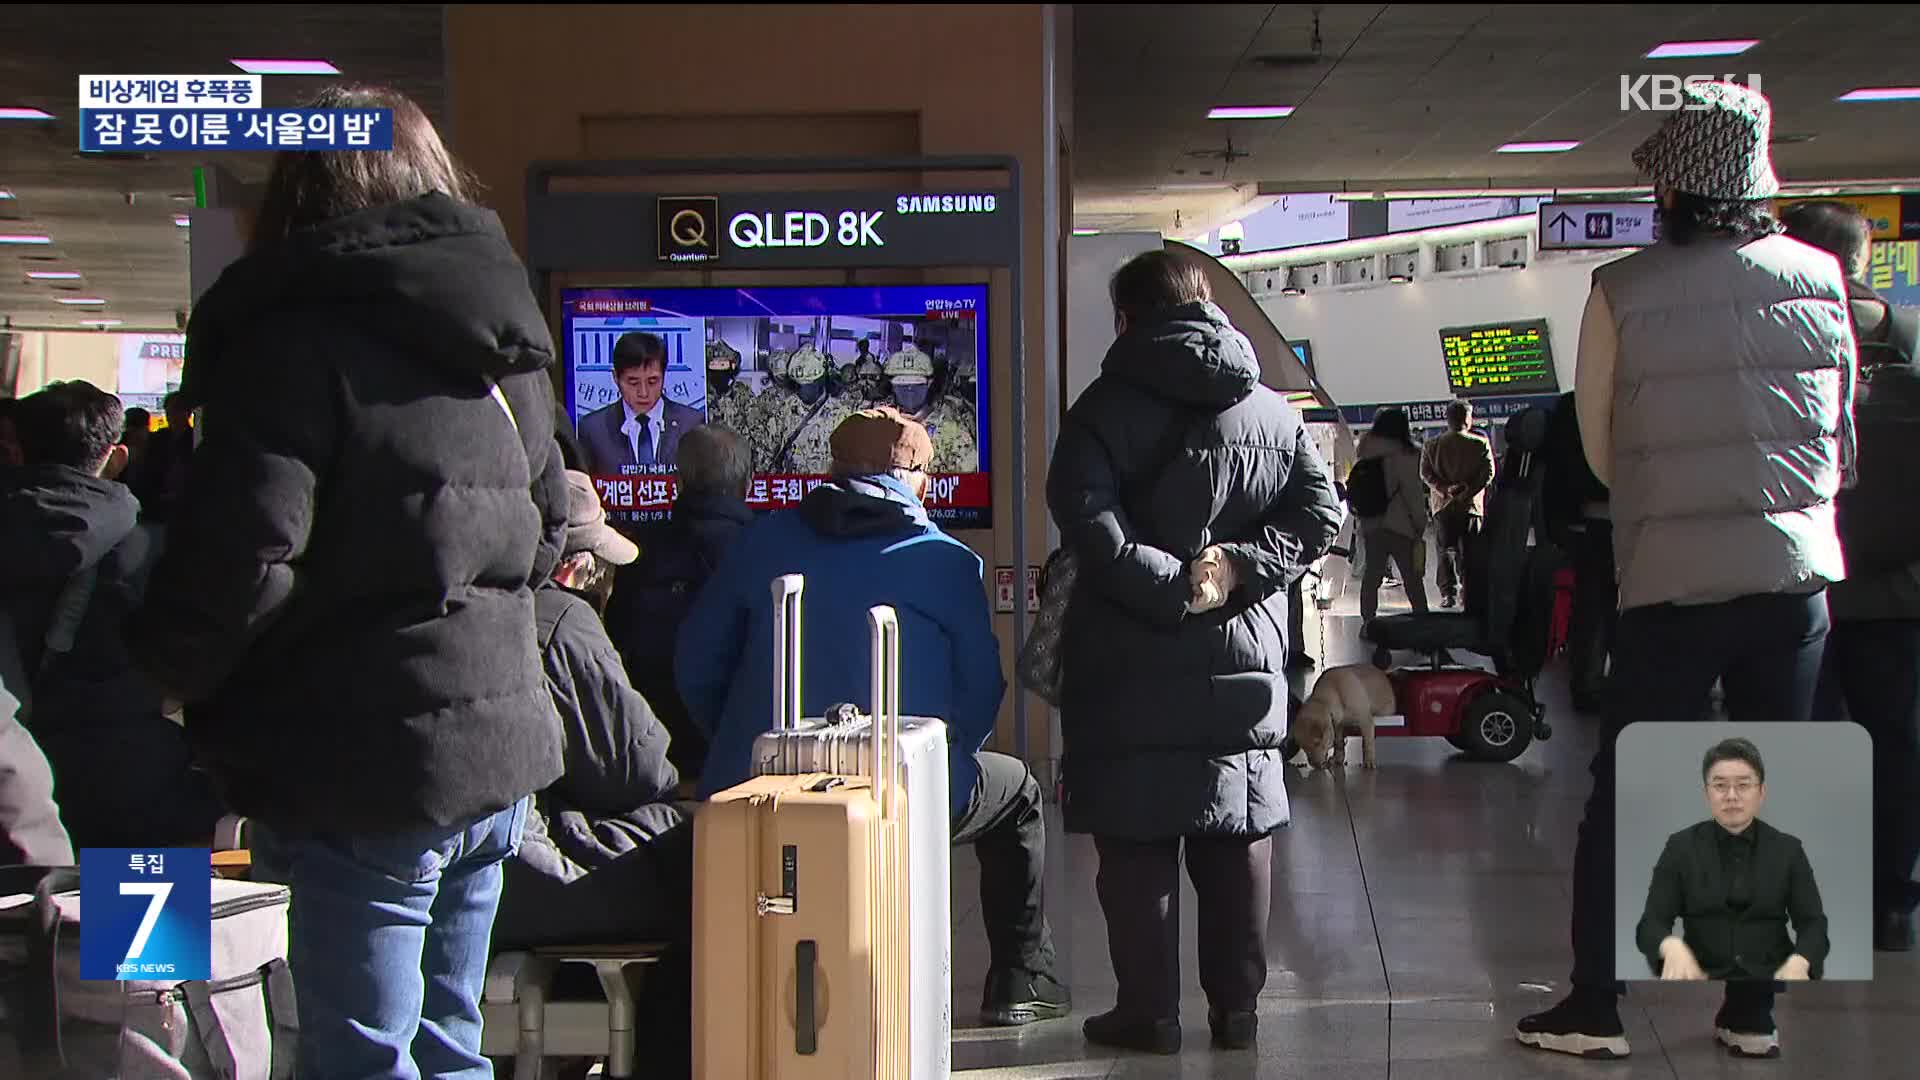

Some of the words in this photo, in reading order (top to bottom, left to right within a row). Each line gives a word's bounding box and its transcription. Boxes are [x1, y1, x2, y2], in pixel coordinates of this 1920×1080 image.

[896, 194, 996, 214] SAMSUNG
[728, 211, 830, 248] QLED
[837, 211, 885, 247] 8K
[670, 253, 707, 263] Quantum
[925, 298, 976, 311] 연합뉴스TV
[941, 310, 960, 320] LIVE
[637, 479, 670, 506] 선포
[771, 478, 803, 505] 국회
